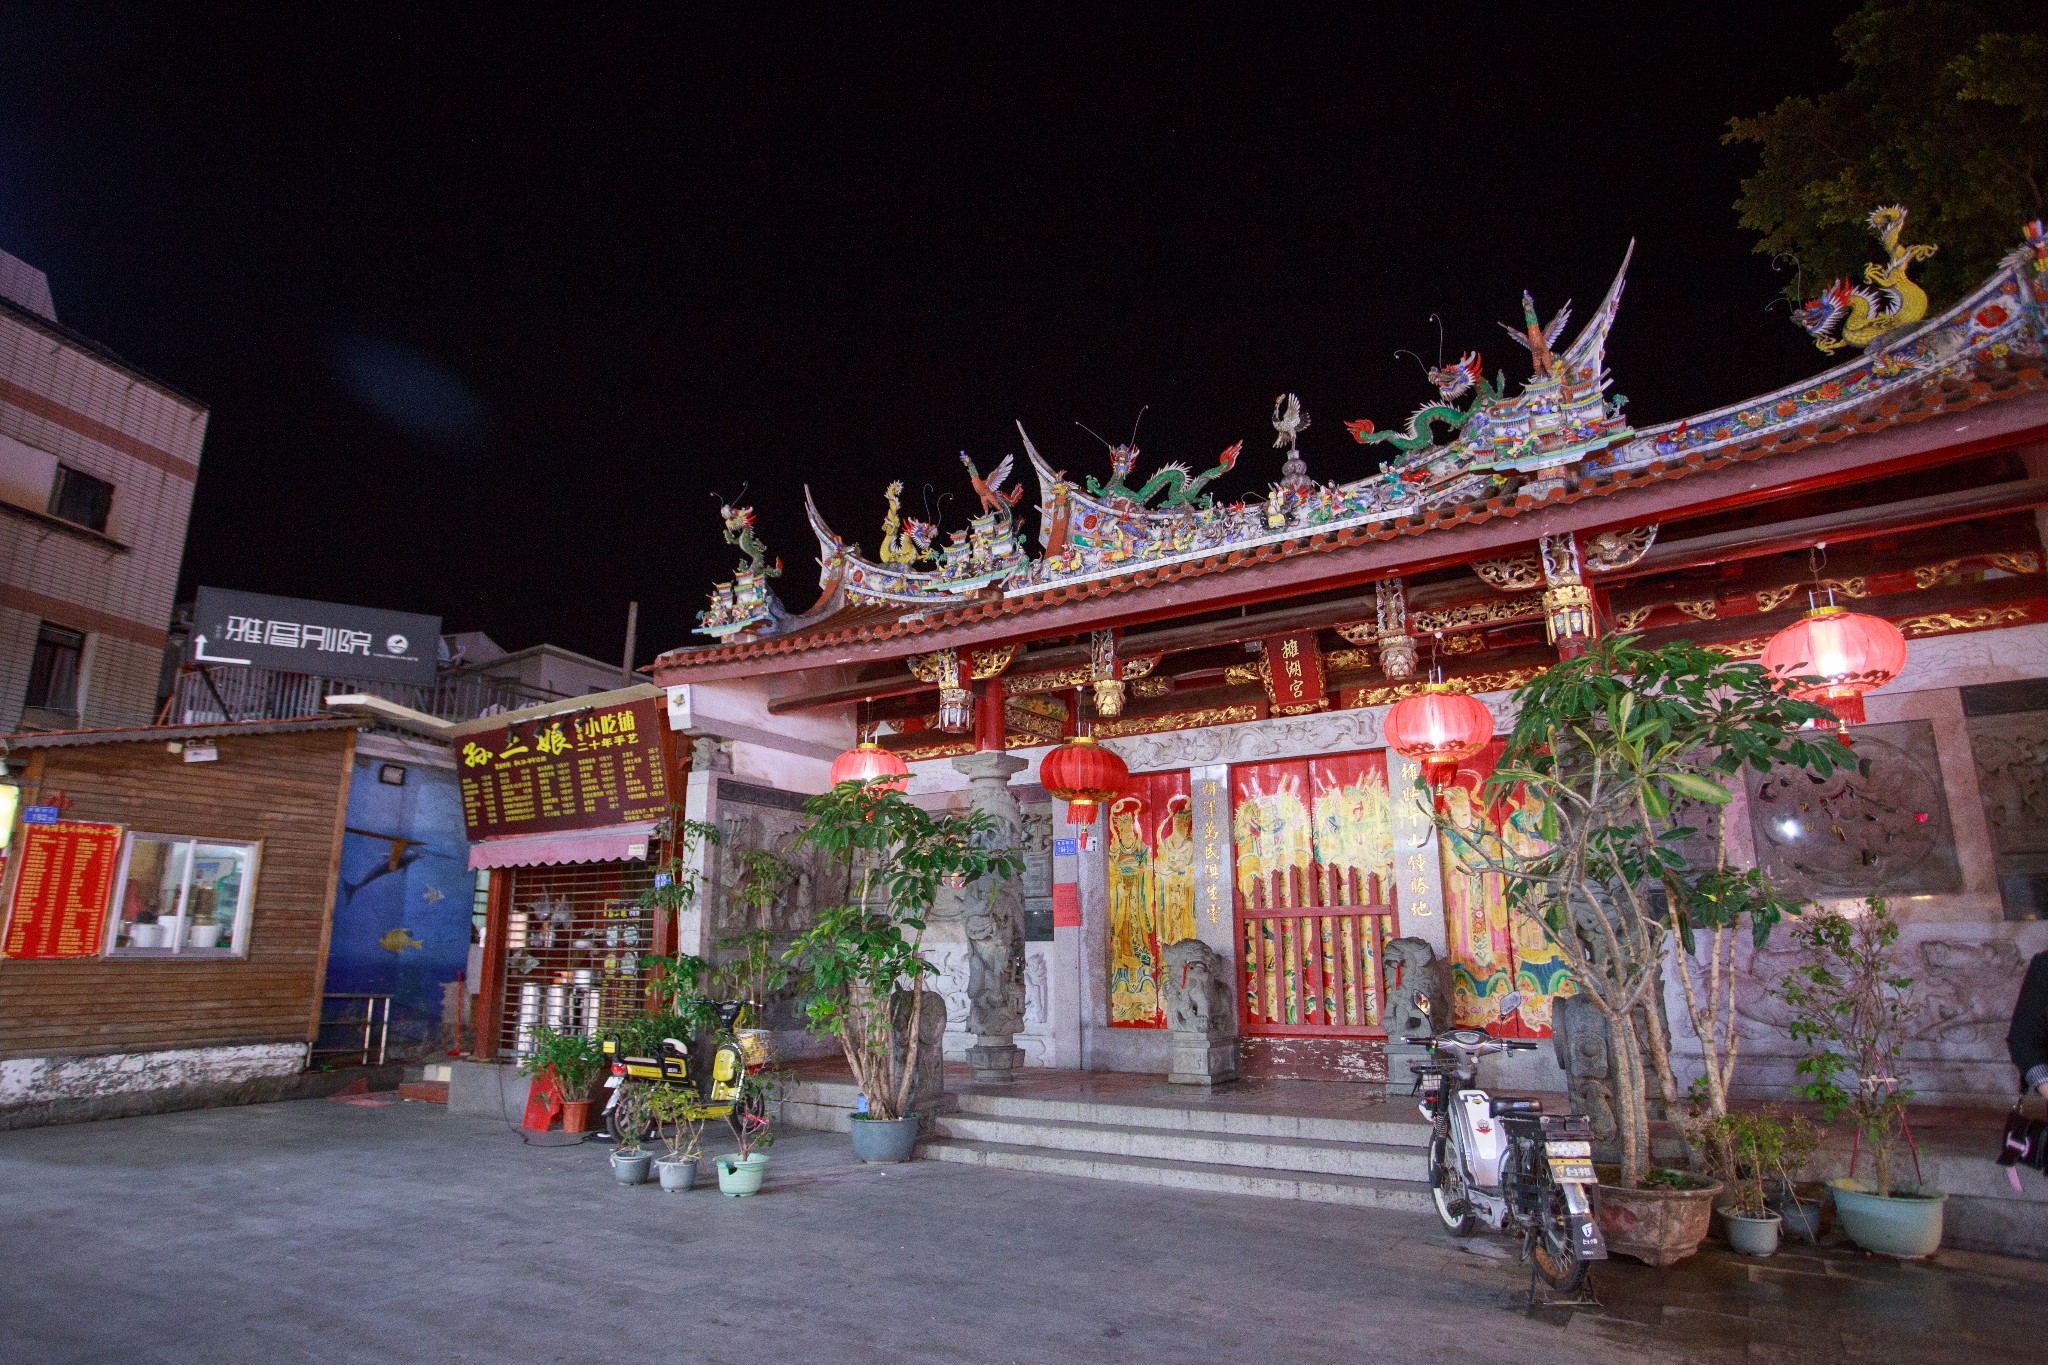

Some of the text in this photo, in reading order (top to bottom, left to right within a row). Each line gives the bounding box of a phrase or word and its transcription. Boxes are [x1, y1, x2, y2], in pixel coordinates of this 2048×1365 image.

[584, 710, 636, 739] 小吃铺
[577, 732, 639, 752] 二十年手艺
